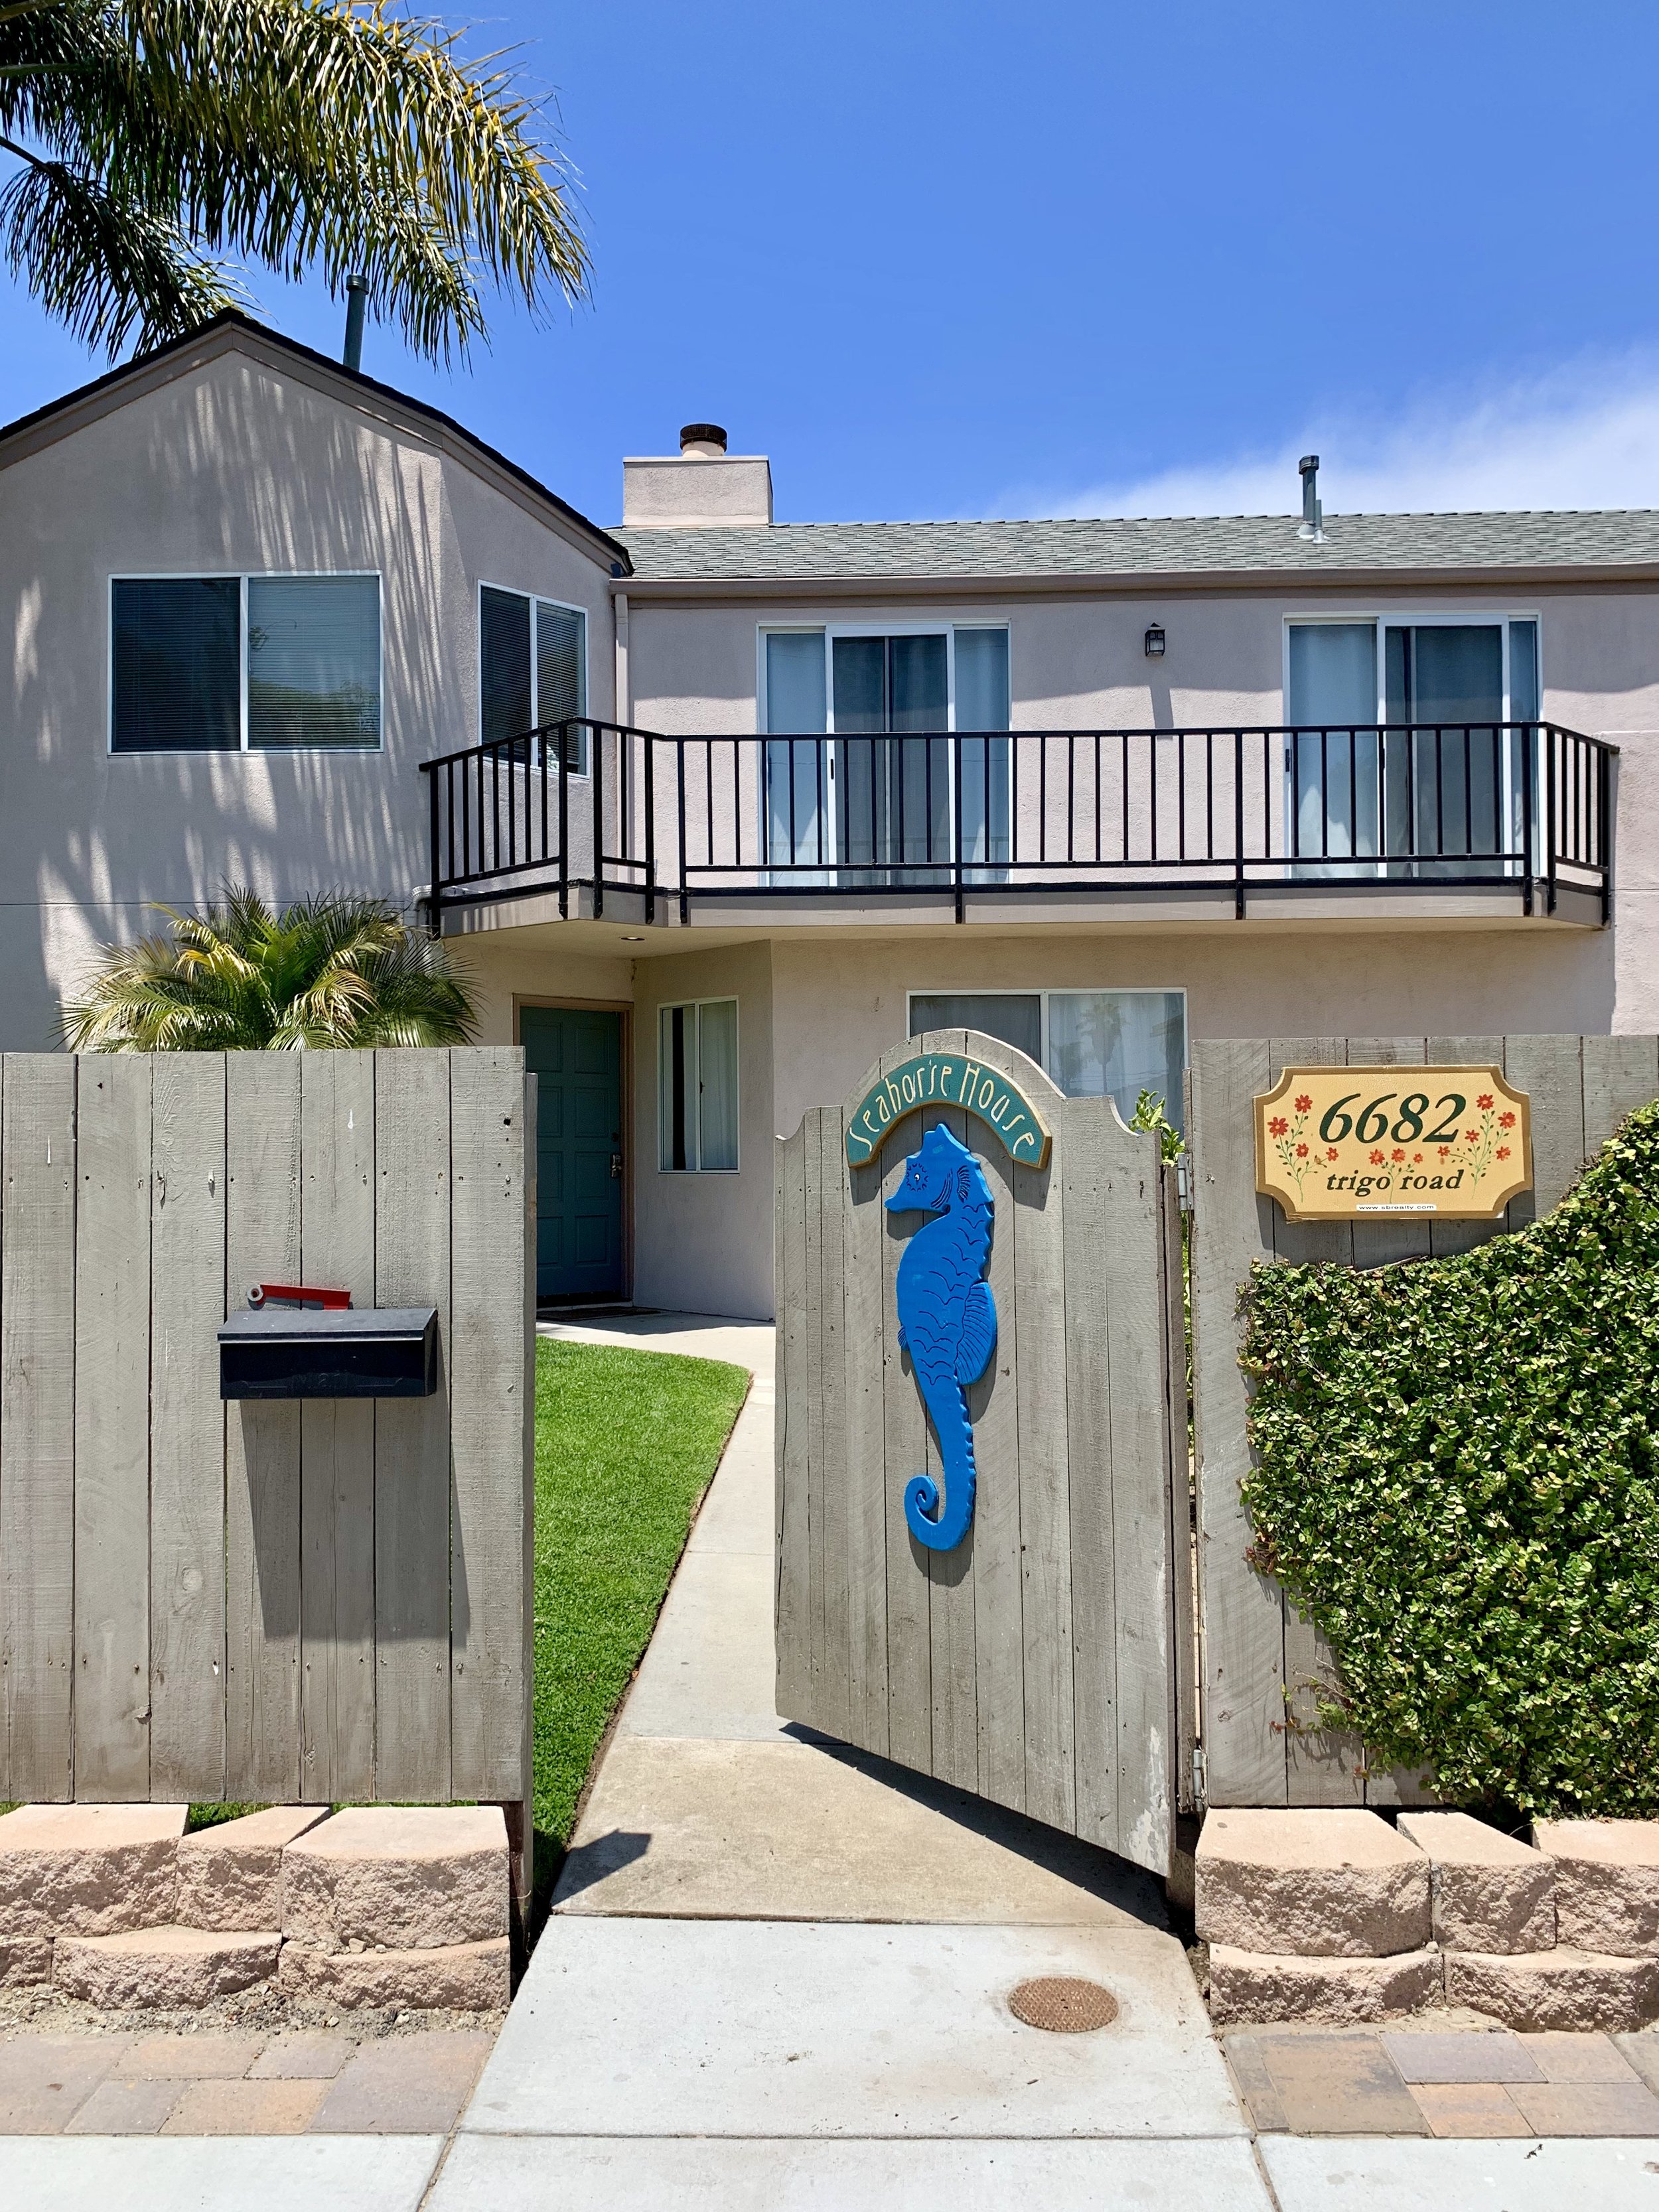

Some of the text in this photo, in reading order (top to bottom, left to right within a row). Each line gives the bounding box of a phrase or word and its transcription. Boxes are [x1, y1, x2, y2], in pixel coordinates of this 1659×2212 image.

[849, 1062, 1035, 1154] Seahorse House
[1319, 1093, 1467, 1143] 6682
[1327, 1169, 1464, 1197] trigo road
